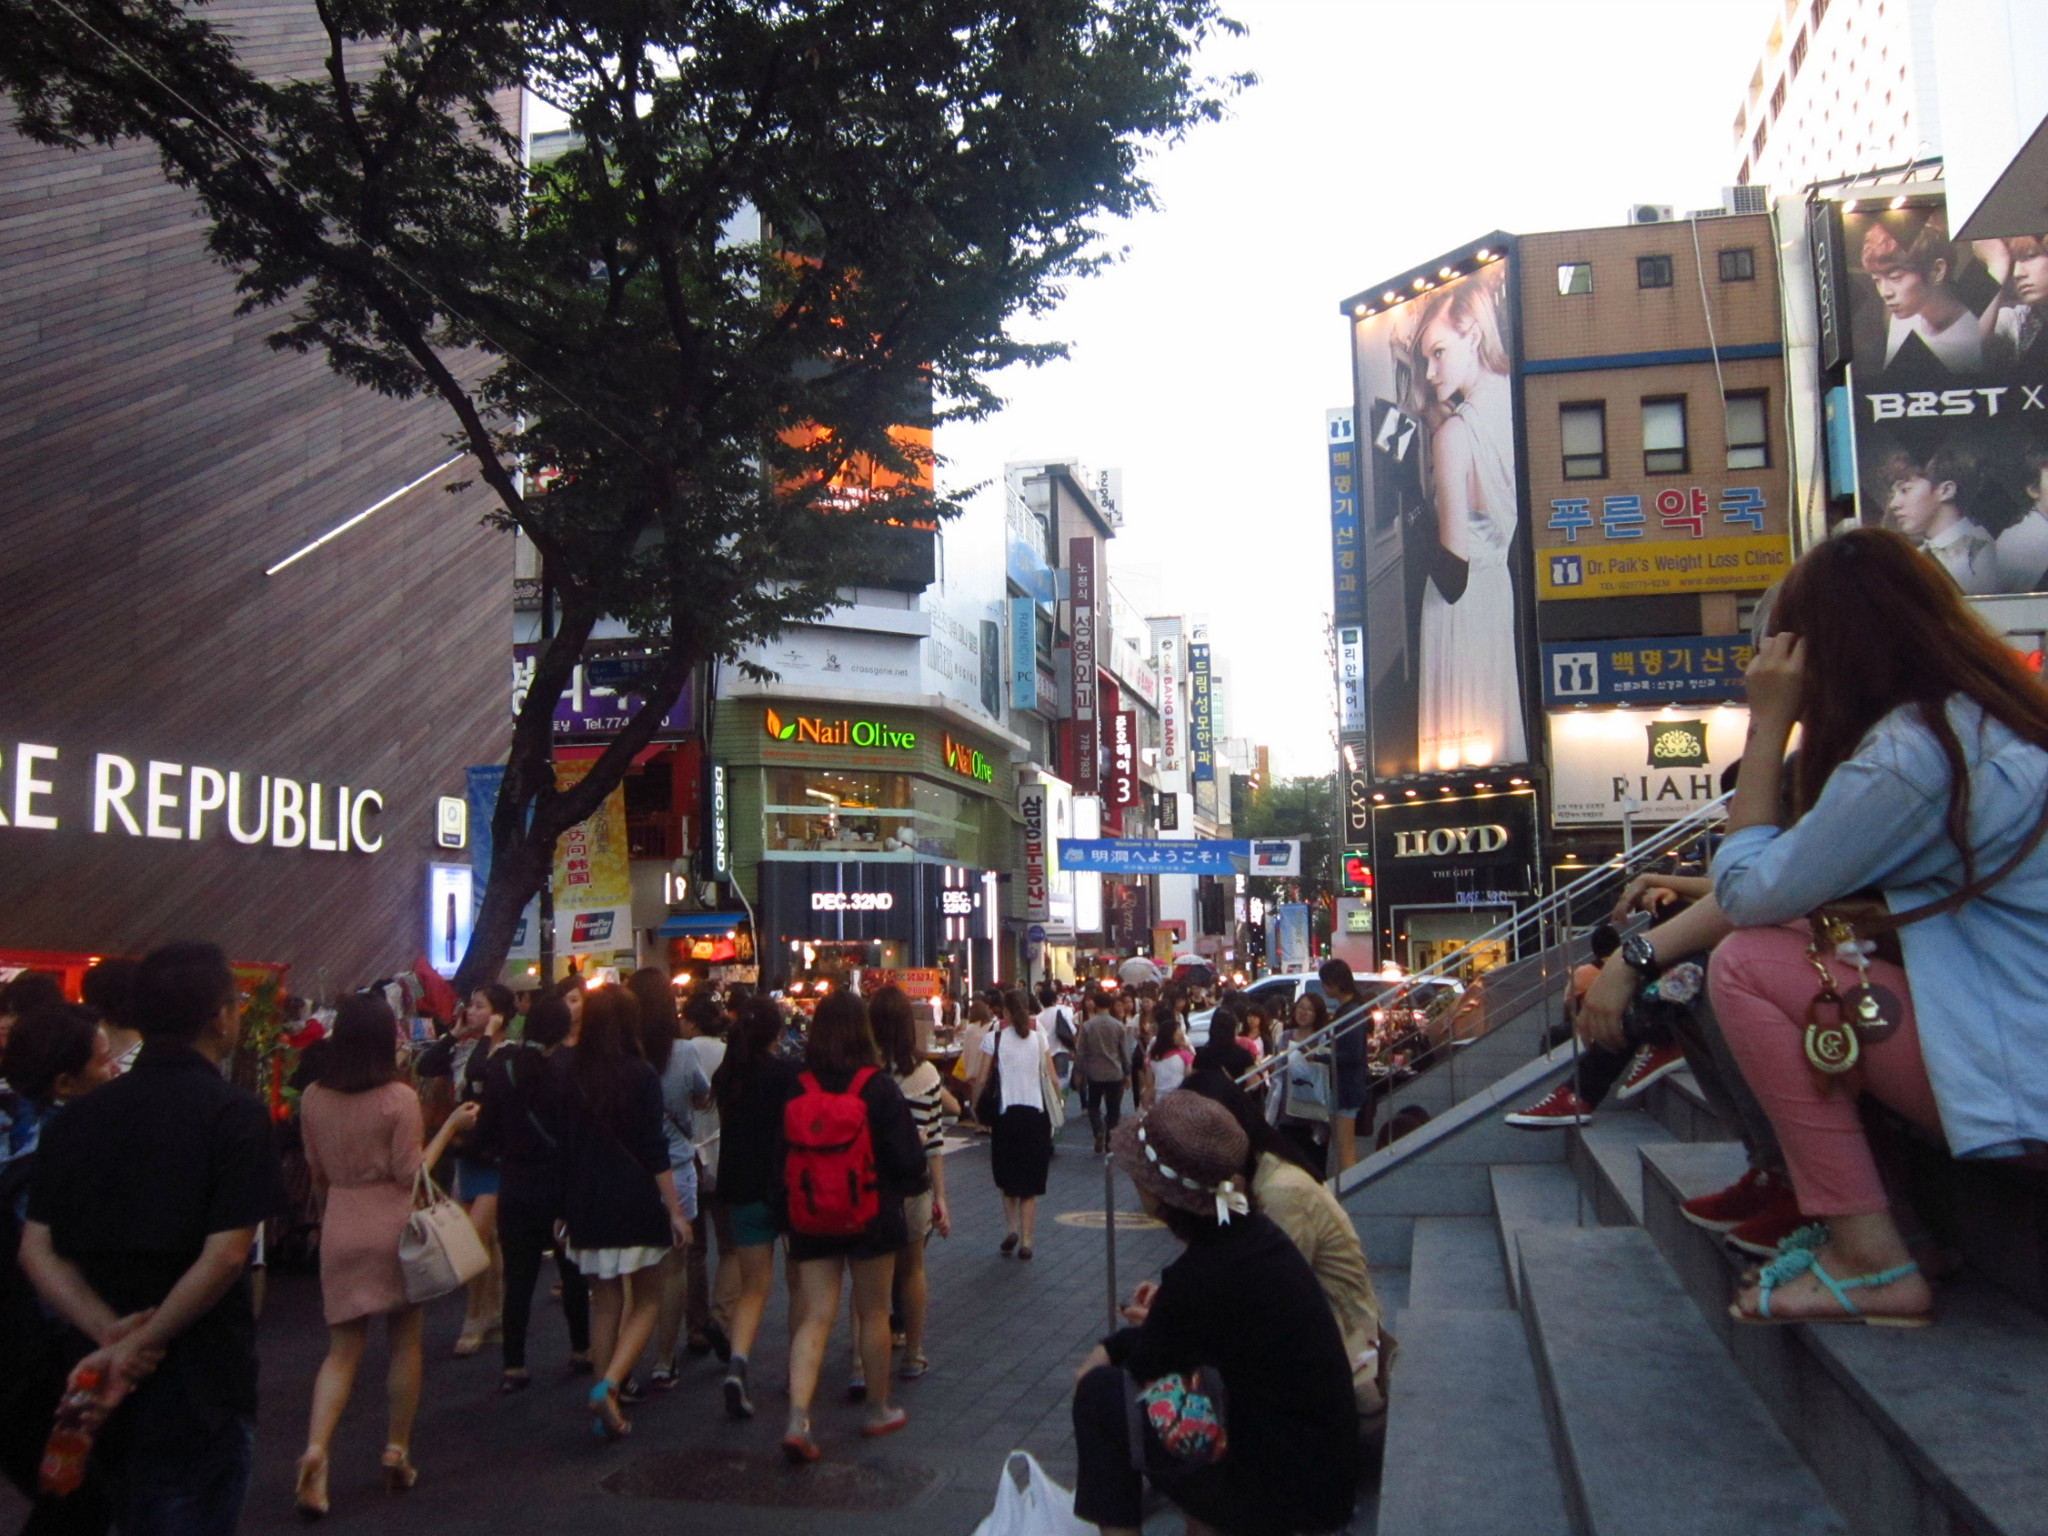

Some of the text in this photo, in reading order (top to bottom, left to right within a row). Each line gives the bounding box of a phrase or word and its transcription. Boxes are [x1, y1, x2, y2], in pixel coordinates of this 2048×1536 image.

[1587, 549, 1784, 575] Dr. Paik's Weight Loss Clinic
[850, 663, 909, 678] crossgene.net
[1017, 671, 1033, 682] PC
[1344, 648, 1358, 709] 리안헤어
[1163, 676, 1175, 758] BANG BANG
[796, 717, 915, 750] Nail Olive
[955, 743, 993, 783] Nail Olive
[0, 742, 384, 854] E REPUBLIC
[1116, 777, 1131, 803] 3
[714, 765, 726, 873] DEC.32ND
[1394, 824, 1508, 858] LLOYD
[1432, 869, 1476, 879] THE GIFT
[811, 892, 893, 911] DEC.32ND
[942, 891, 971, 903] DEC.
[942, 903, 972, 914] 32ND
